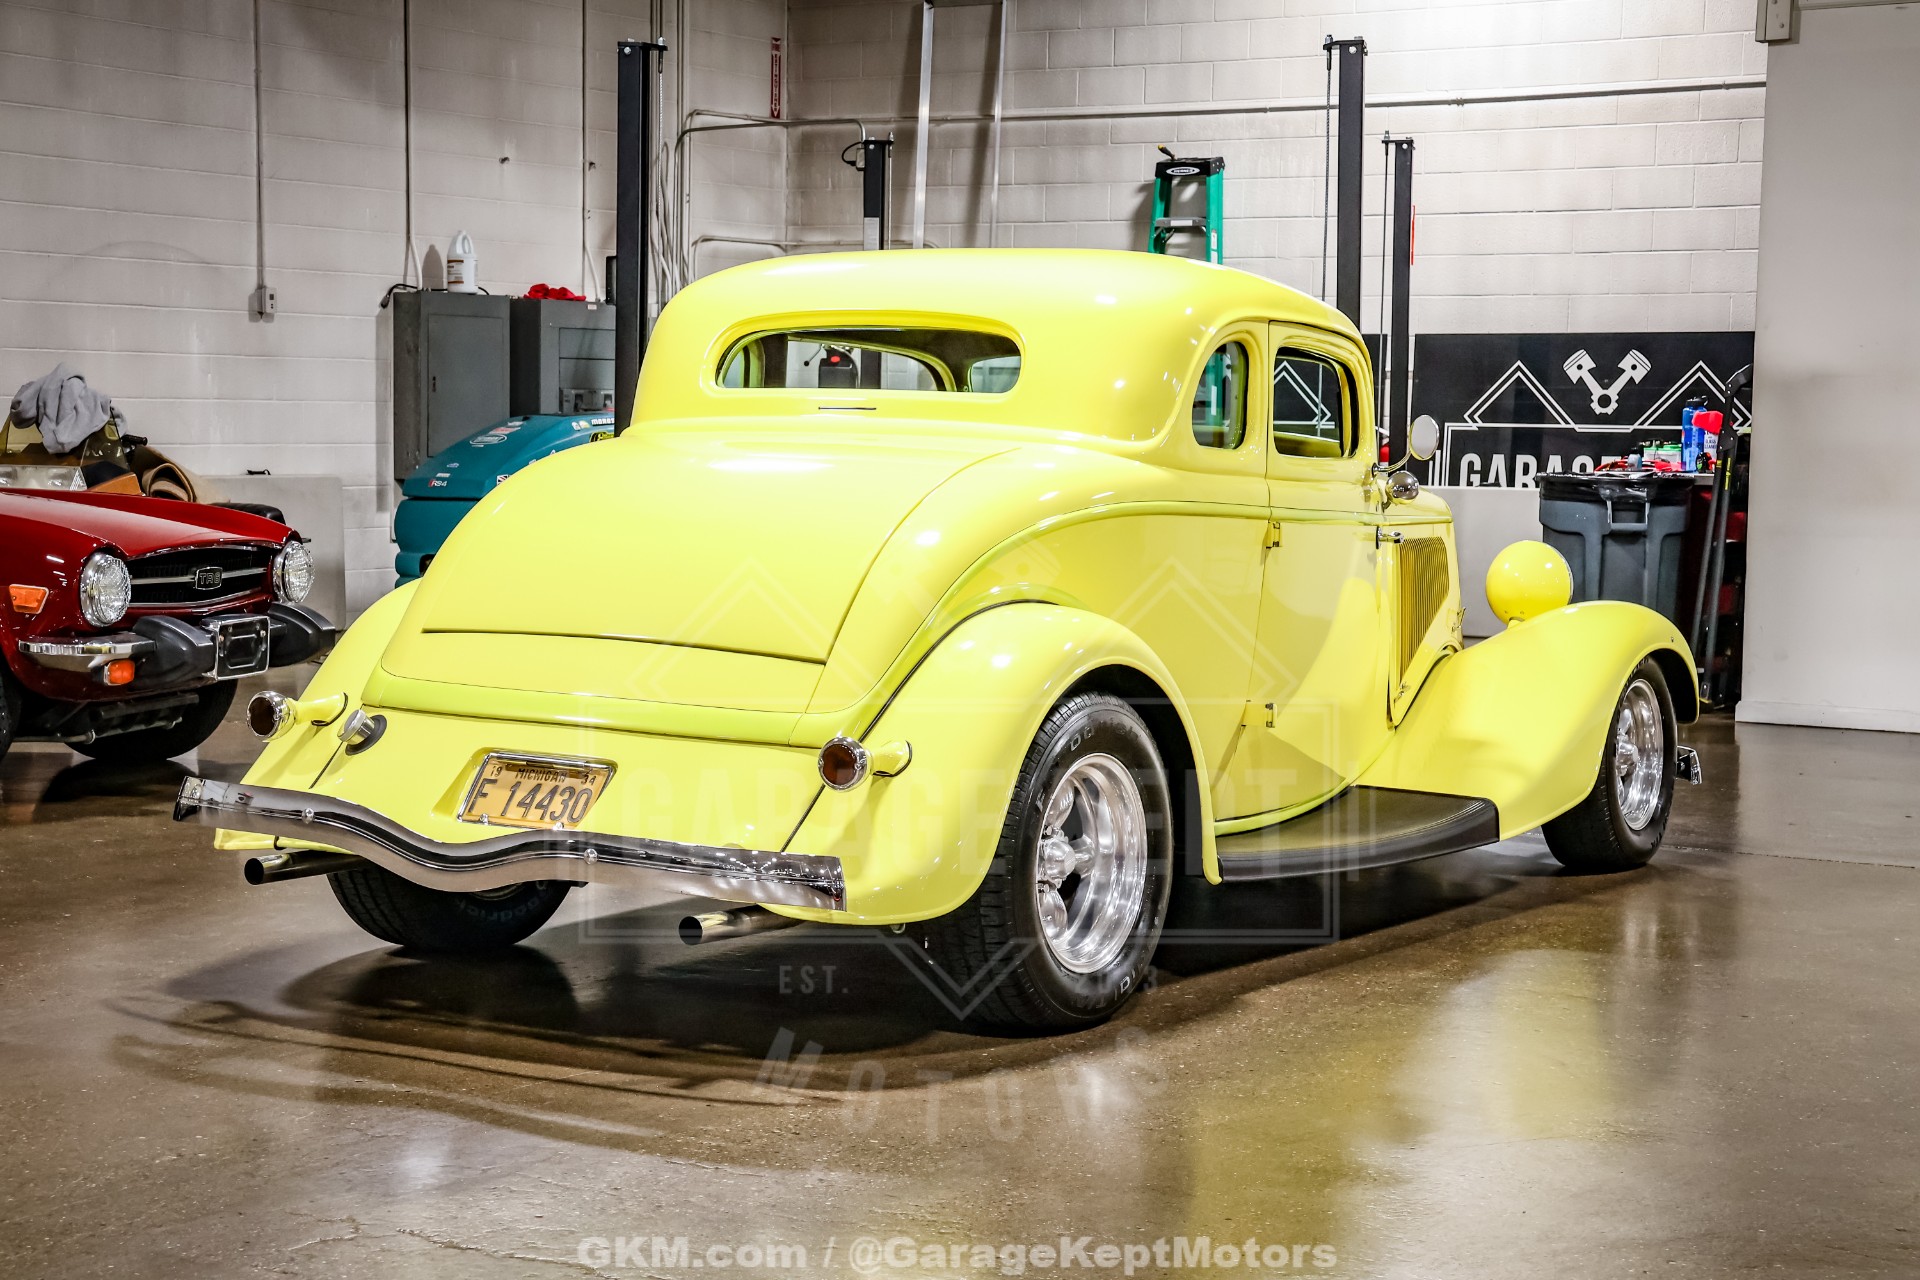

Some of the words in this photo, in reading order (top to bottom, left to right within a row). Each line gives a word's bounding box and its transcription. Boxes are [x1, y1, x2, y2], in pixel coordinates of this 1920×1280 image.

[1460, 453, 1621, 488] GARA
[200, 572, 220, 585] TR6
[515, 767, 568, 784] MICHIGAN
[468, 778, 498, 813] F
[501, 781, 593, 823] 14430
